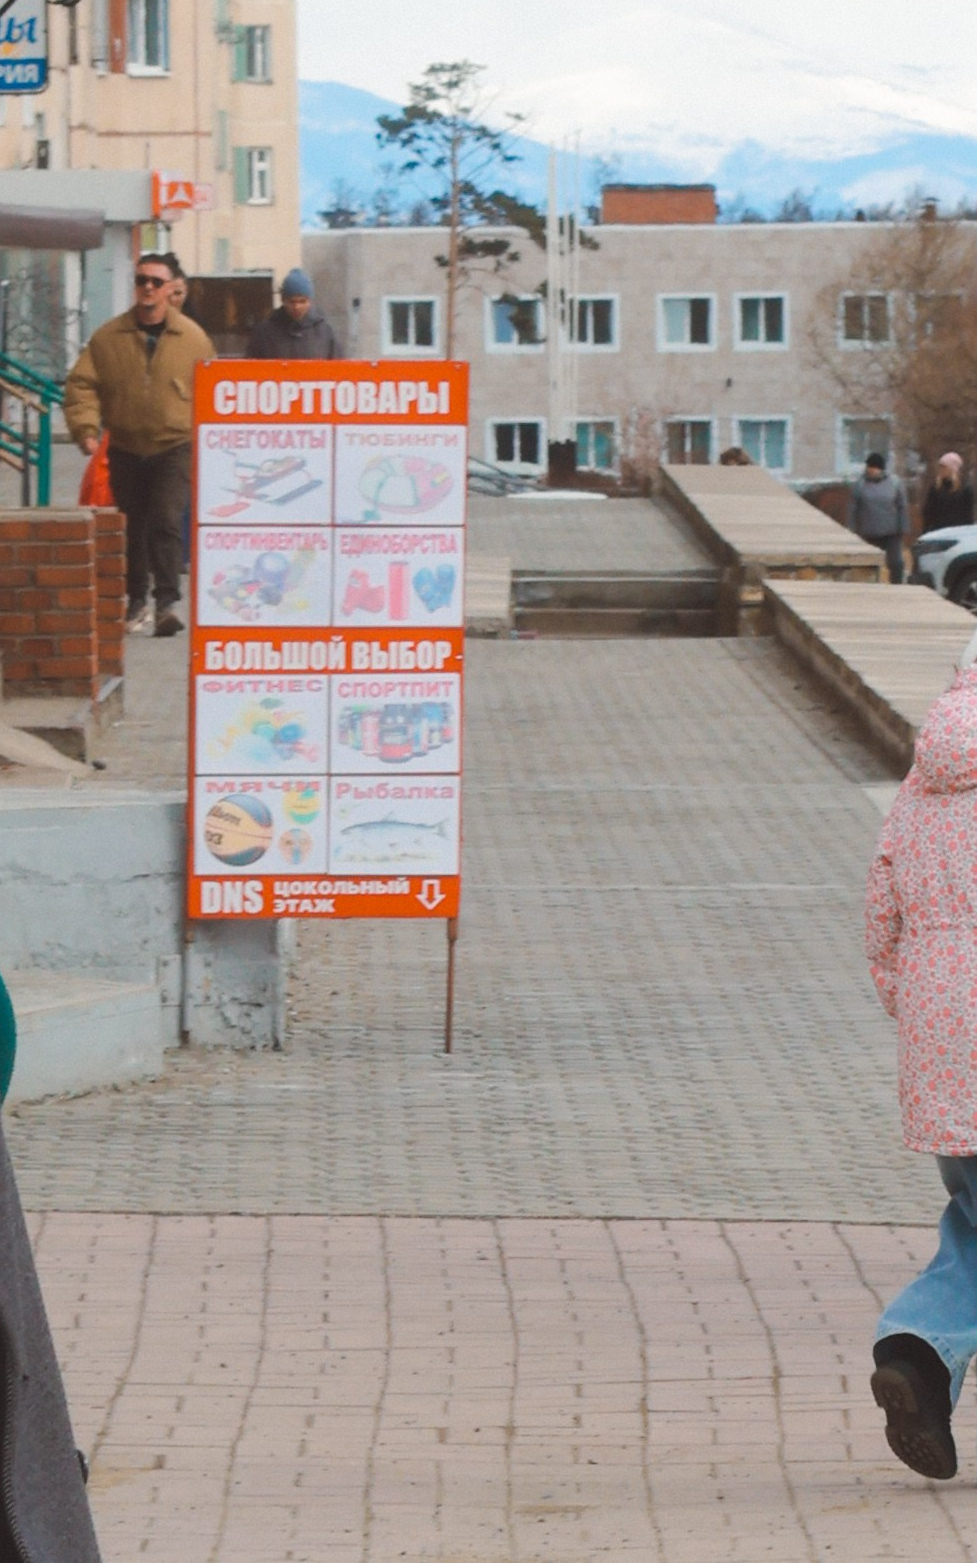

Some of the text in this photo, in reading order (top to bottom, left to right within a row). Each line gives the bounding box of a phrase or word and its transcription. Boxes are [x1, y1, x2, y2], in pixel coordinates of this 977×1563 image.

[213, 380, 450, 415] СПОРТТОВАРЫ
[205, 429, 327, 449] СНЕГОКАТЫ
[344, 433, 459, 447] ТЮБИНГИ
[204, 532, 329, 551] СПОРТИНВЕНТАРЬ
[339, 534, 458, 557] ЕДИНОБОРСТВА
[204, 635, 453, 670] БОЛЬШОЙ ВЫБОР
[201, 679, 323, 693] ФИТНЕС
[338, 681, 454, 698] СПОРТПИТ
[335, 782, 454, 799] Рыбалка
[273, 877, 410, 897] ЦОКОЛЬНЫЙ
[200, 880, 264, 914] DNS
[273, 898, 336, 913] ЭТАЖ
